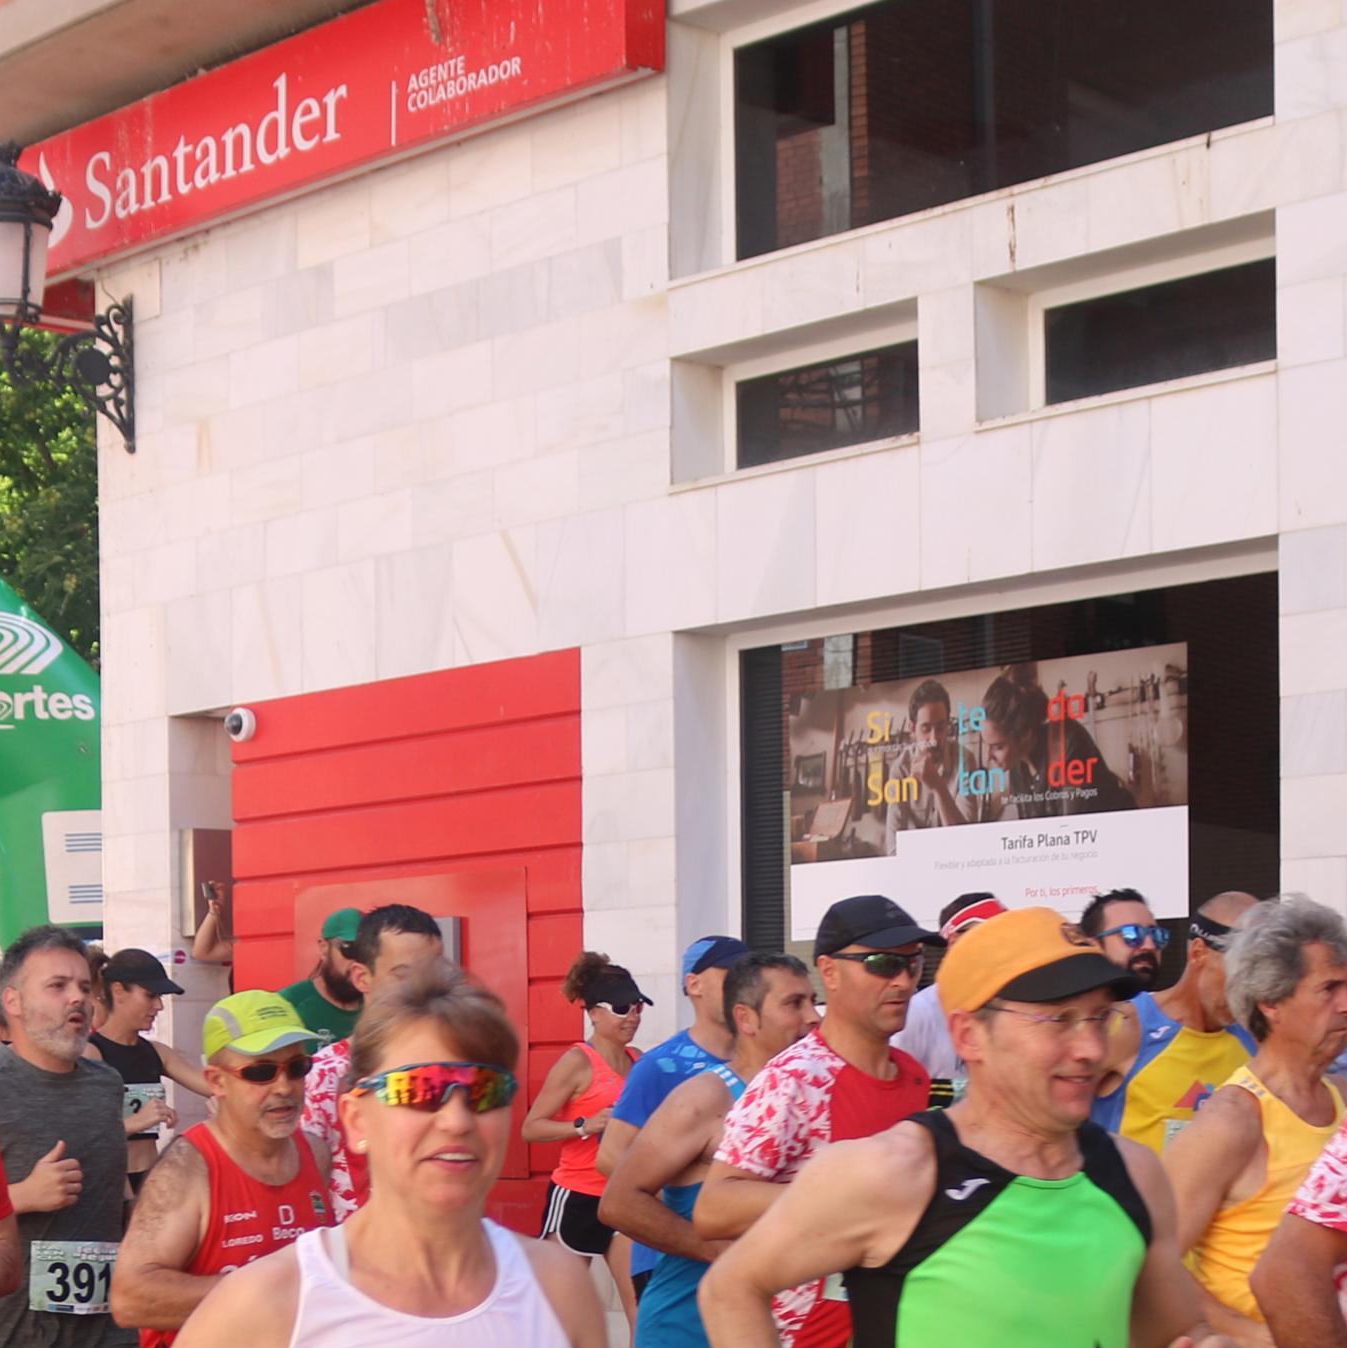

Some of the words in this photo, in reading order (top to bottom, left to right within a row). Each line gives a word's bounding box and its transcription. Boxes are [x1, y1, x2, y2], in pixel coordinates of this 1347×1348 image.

[407, 55, 465, 93] AGENTE
[407, 56, 521, 112] COLABORADOR
[84, 73, 348, 230] Santander
[866, 710, 891, 744] Si
[957, 703, 987, 733] te
[1048, 689, 1085, 721] da
[867, 772, 918, 806] San
[958, 768, 1005, 796] tan
[1048, 756, 1098, 787] der
[1001, 835, 1034, 851] Tarifa
[1037, 833, 1070, 848] Plana
[1074, 829, 1098, 844] TPV
[1025, 887, 1039, 897] Por
[1049, 886, 1060, 896] los
[46, 1262, 111, 1303] 391
